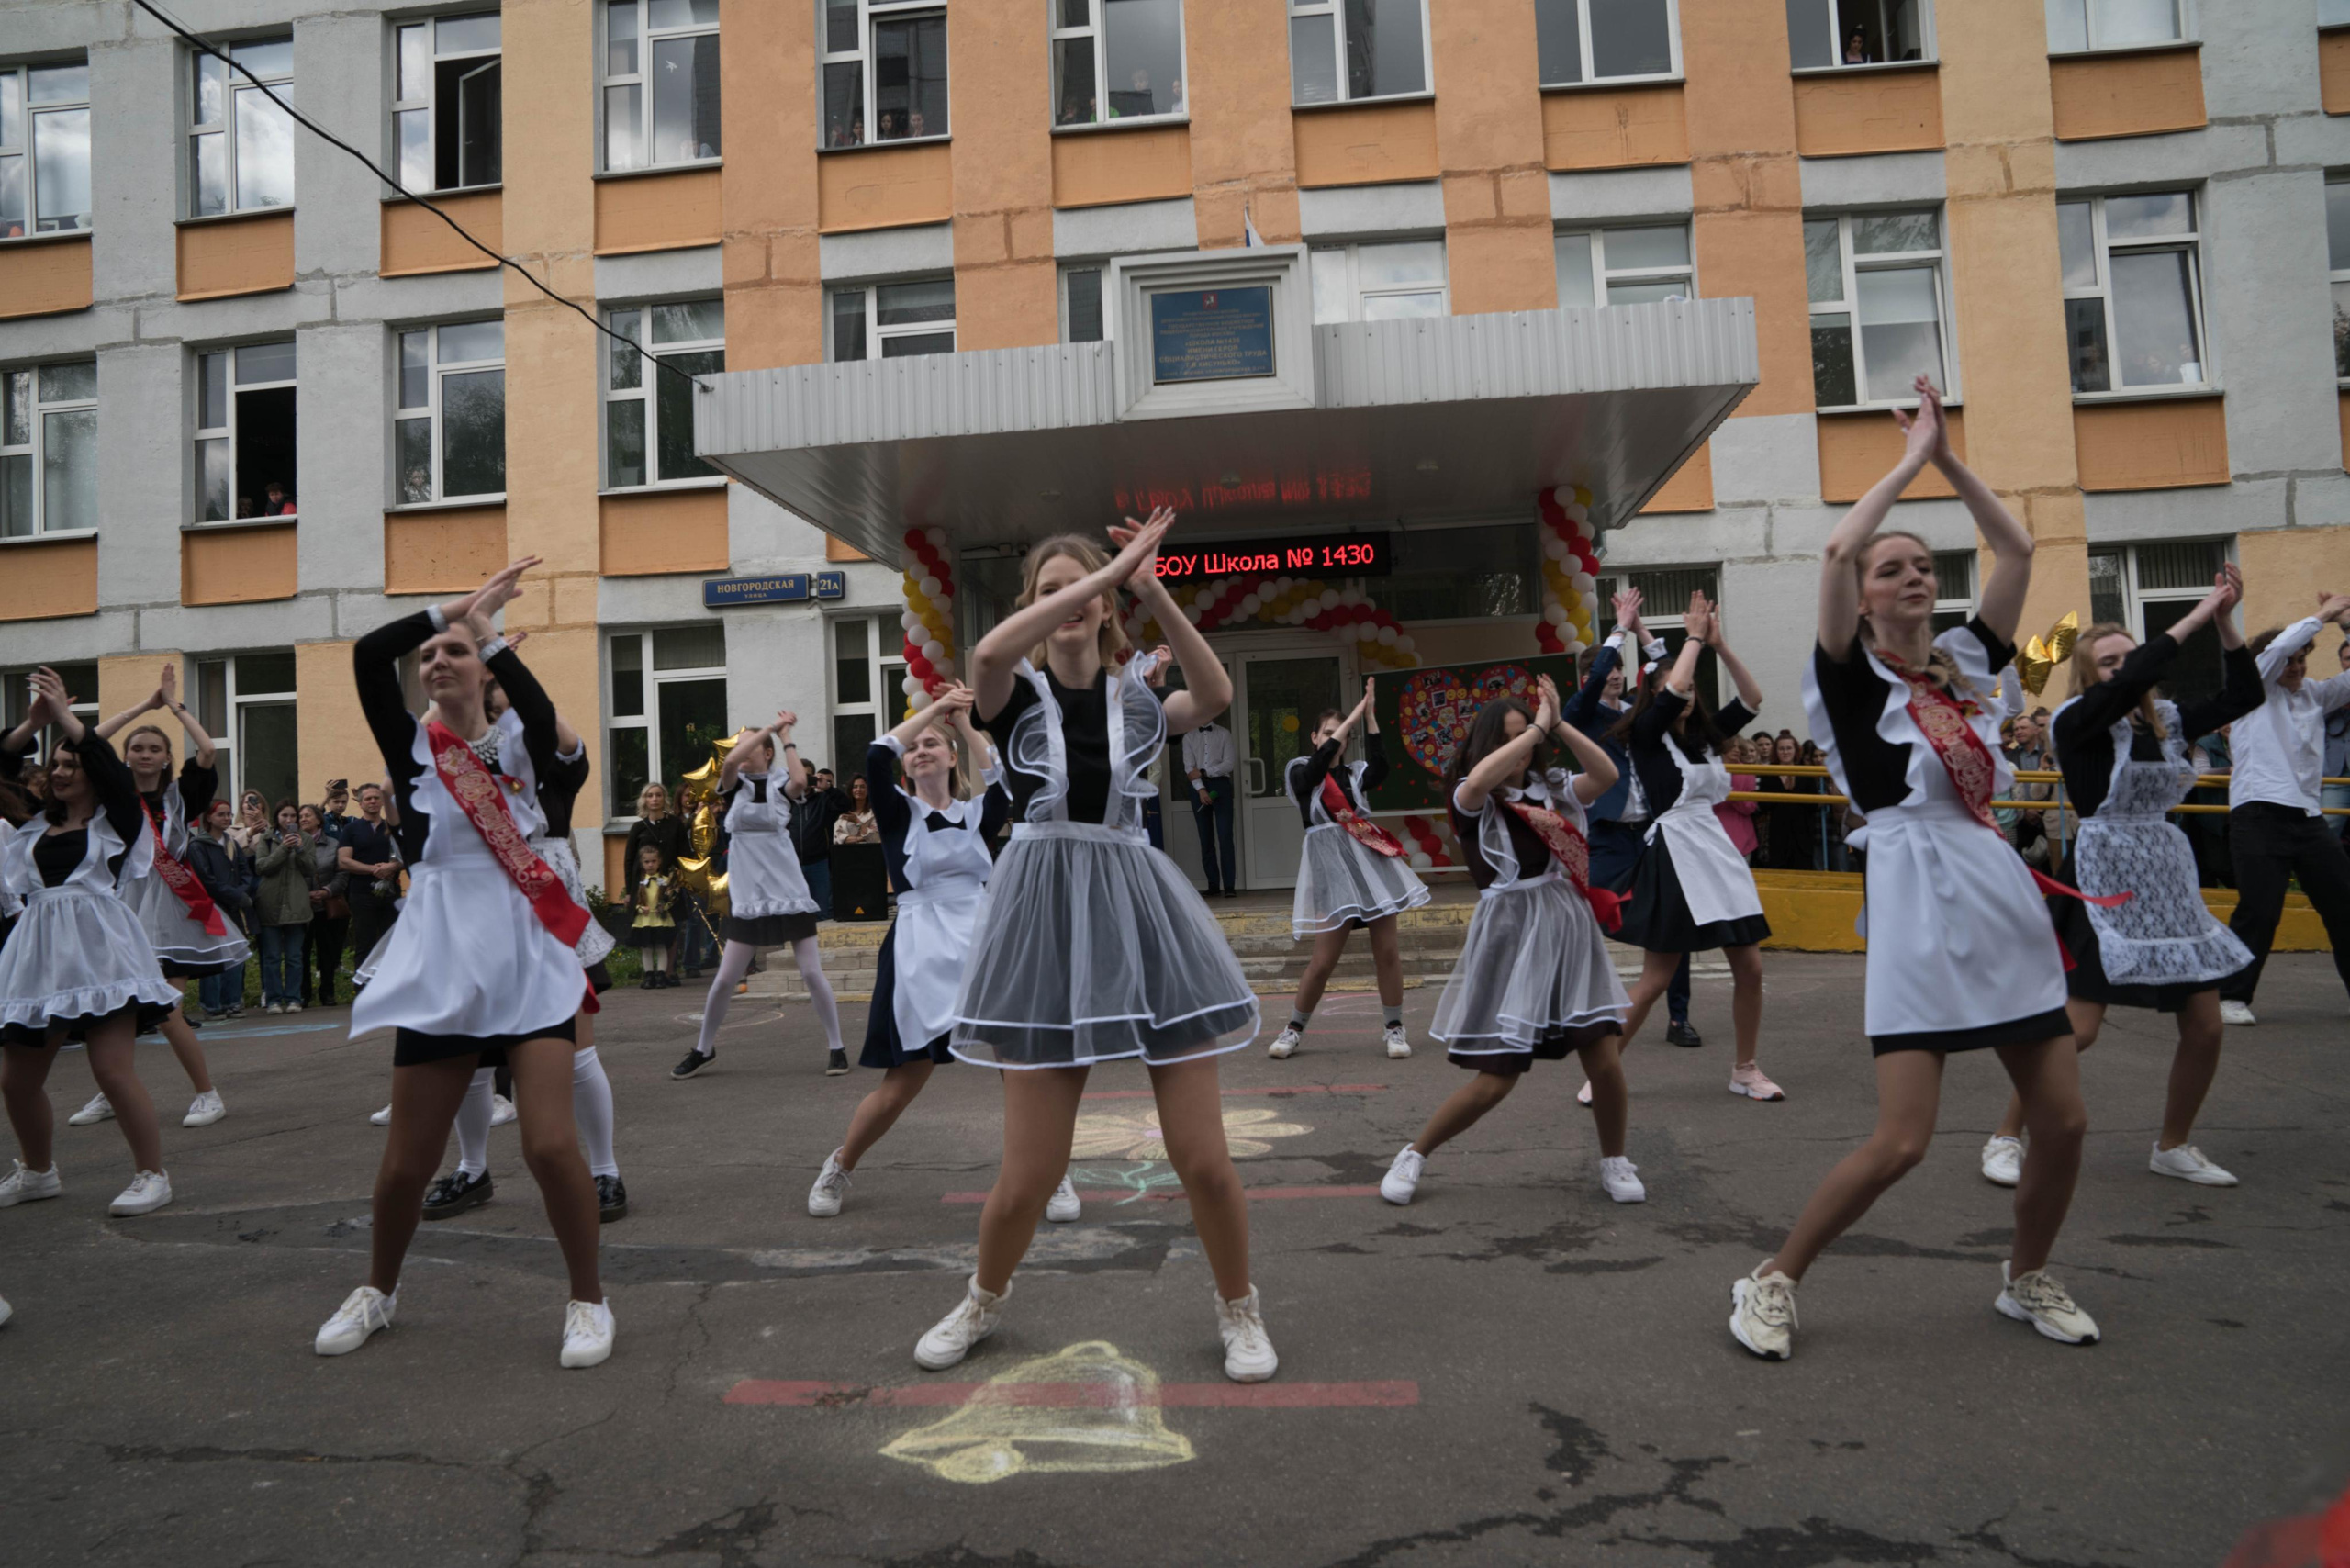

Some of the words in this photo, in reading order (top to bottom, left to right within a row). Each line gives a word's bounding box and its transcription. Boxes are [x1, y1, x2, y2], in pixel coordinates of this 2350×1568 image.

[1159, 352, 1243, 363] СОЦИАЛИСТИЧЕСКОГО
[1204, 553, 1279, 574] Школа
[1287, 547, 1314, 568] №
[1322, 543, 1374, 566] 1430
[717, 579, 794, 593] НОВГОРОДСКАЯ
